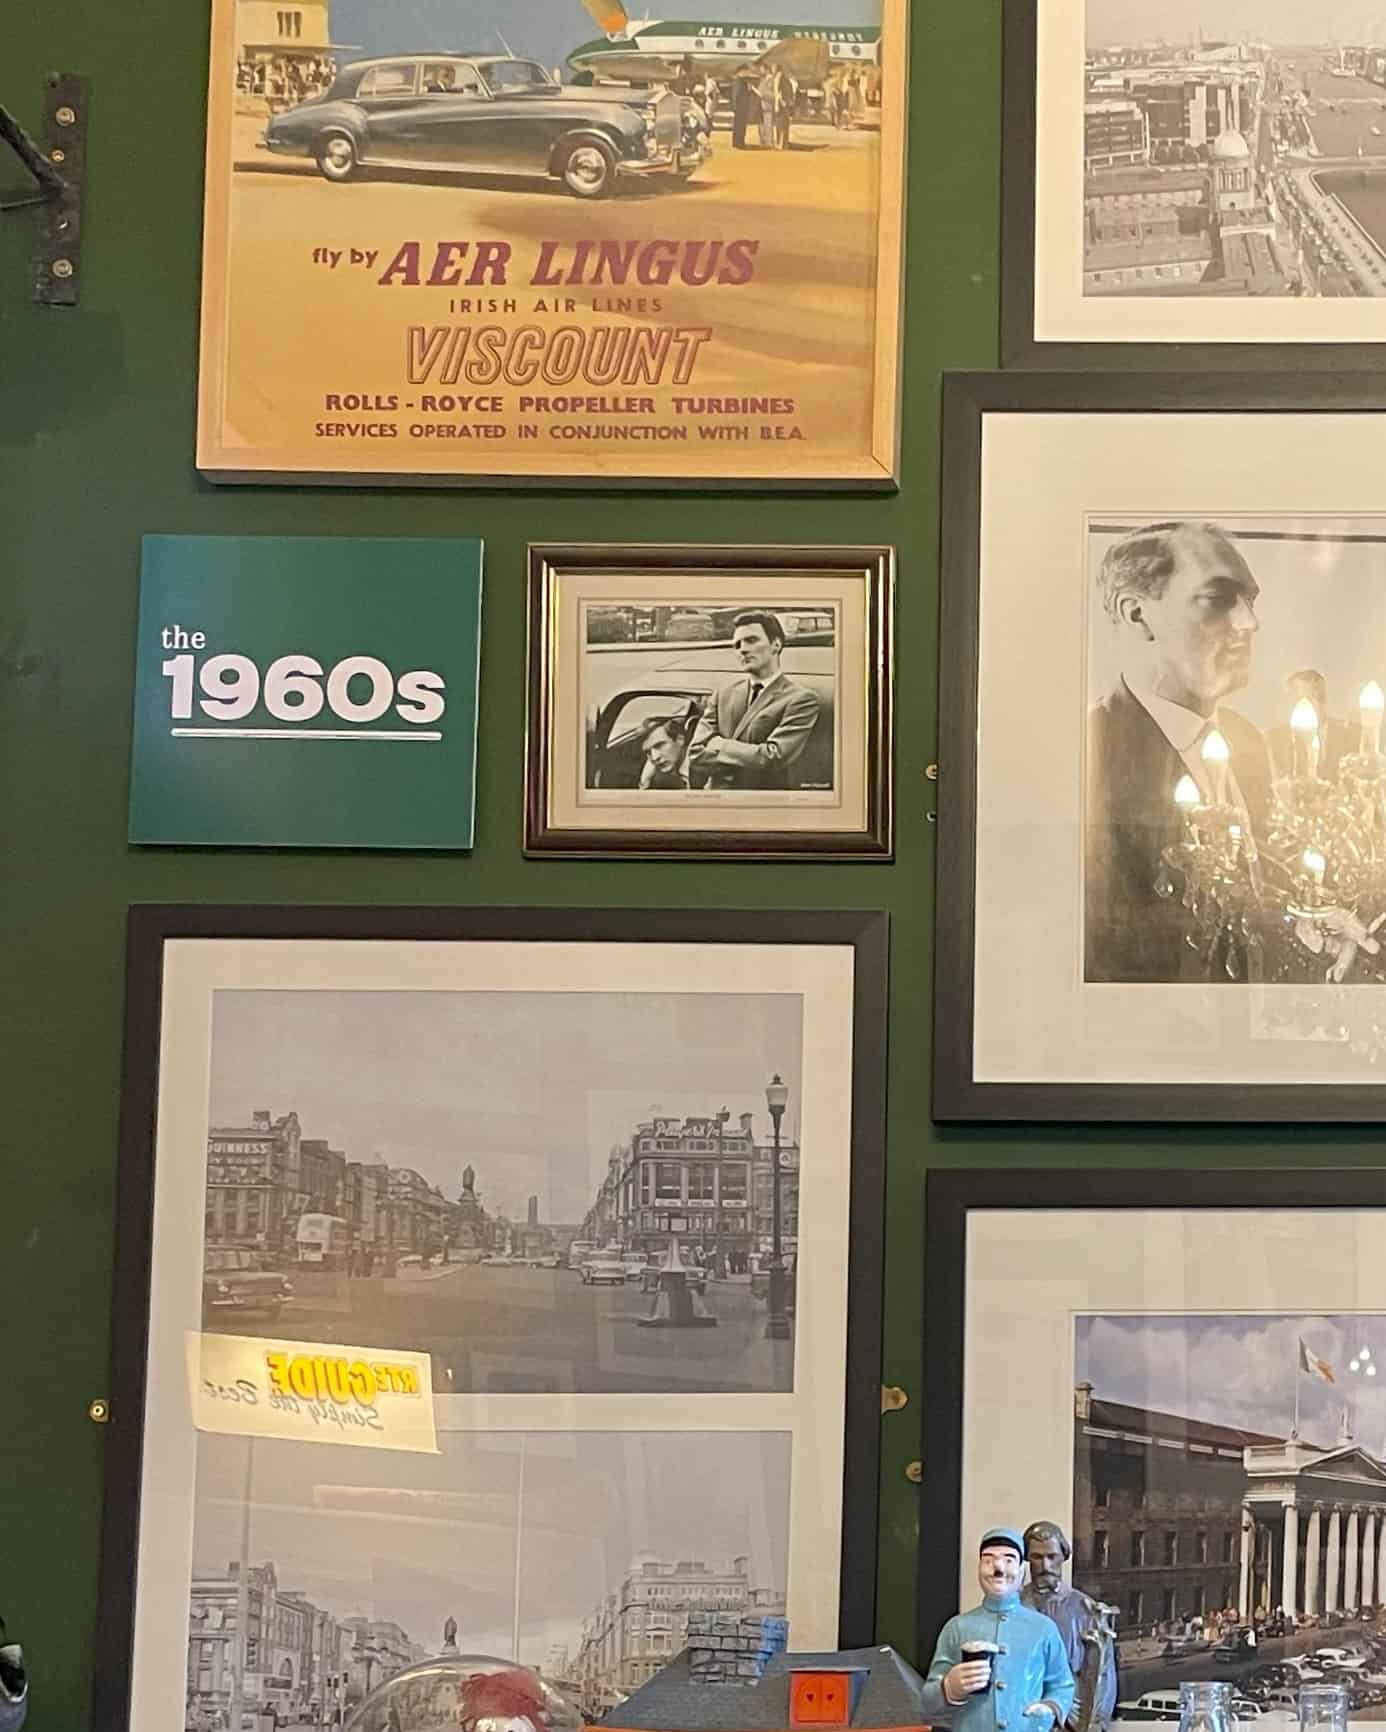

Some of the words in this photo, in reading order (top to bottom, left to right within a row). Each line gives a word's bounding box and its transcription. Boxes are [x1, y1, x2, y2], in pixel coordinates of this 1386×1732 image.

[313, 246, 343, 268] fly
[349, 246, 378, 270] by
[378, 240, 512, 287] AER
[530, 239, 758, 286] LINGUS
[449, 298, 517, 313] IRISH
[533, 298, 576, 313] AIR
[592, 298, 662, 313] LINES
[405, 325, 711, 386] VISCOUNT
[519, 395, 654, 415] PROPELLER
[671, 396, 794, 415] TURBINES
[315, 422, 397, 438] SERVICES
[410, 422, 505, 439] OPERATED
[517, 423, 537, 439] IN
[549, 423, 687, 440] CONJUNCTION
[698, 424, 748, 440] WITH
[162, 625, 206, 649] the
[162, 654, 445, 723] 1960s
